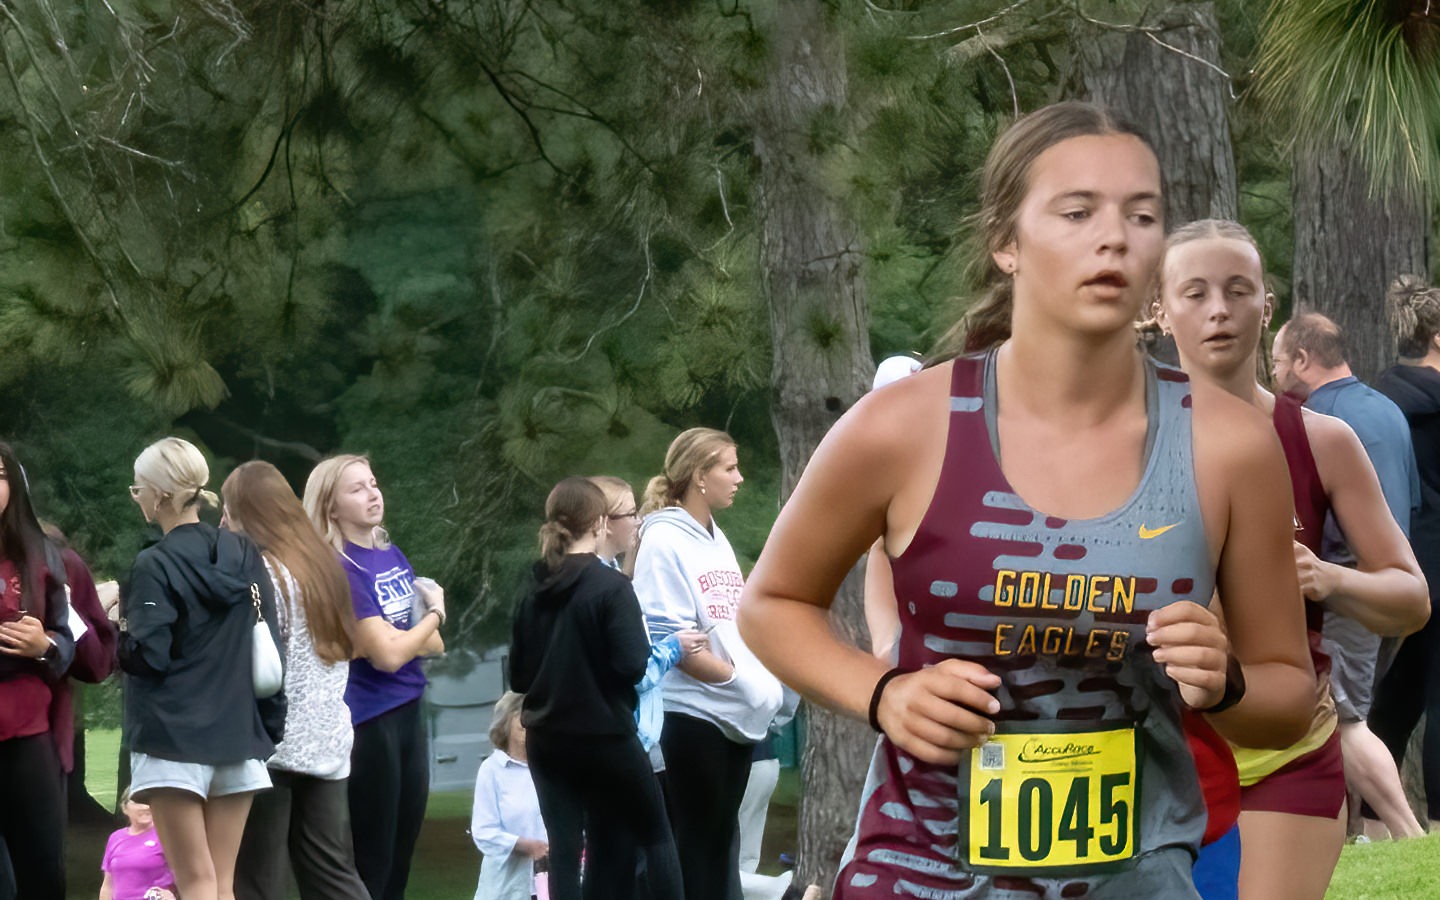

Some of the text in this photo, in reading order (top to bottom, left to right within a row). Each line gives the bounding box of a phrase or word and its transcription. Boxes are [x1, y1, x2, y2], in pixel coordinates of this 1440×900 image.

[994, 569, 1135, 614] GOLDEN
[994, 624, 1131, 662] EAGLES
[979, 773, 1131, 862] 1045
